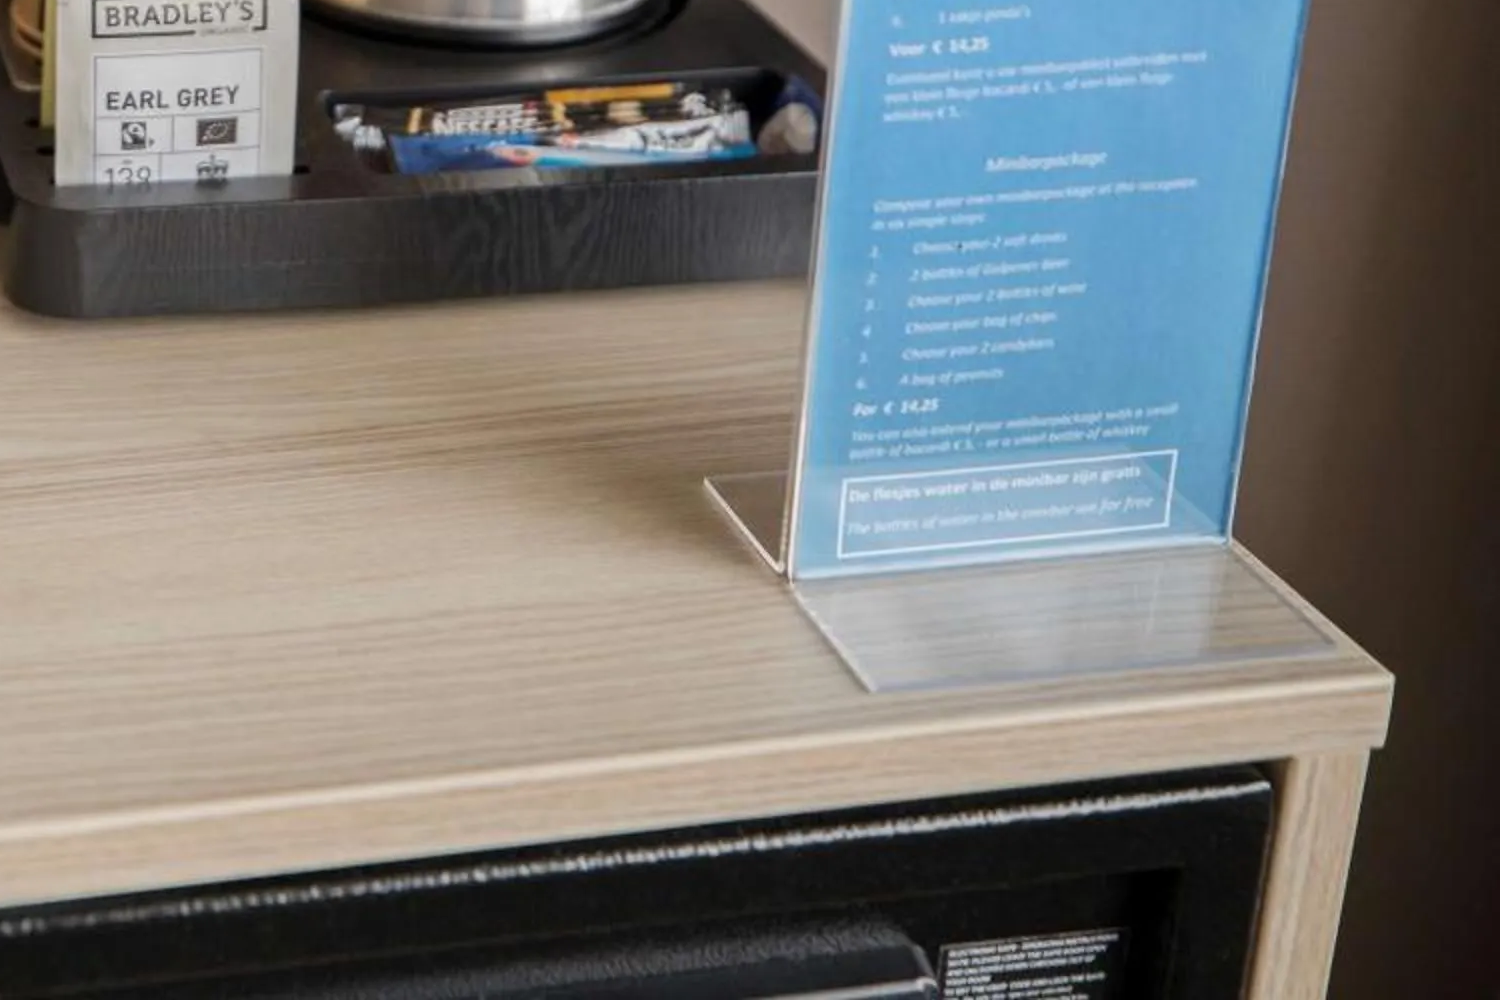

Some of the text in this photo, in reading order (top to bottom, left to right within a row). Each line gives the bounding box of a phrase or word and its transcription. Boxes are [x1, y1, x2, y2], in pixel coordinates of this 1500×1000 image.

[105, 1, 254, 27] BRADLEY'S
[107, 85, 238, 111] EARL GREY
